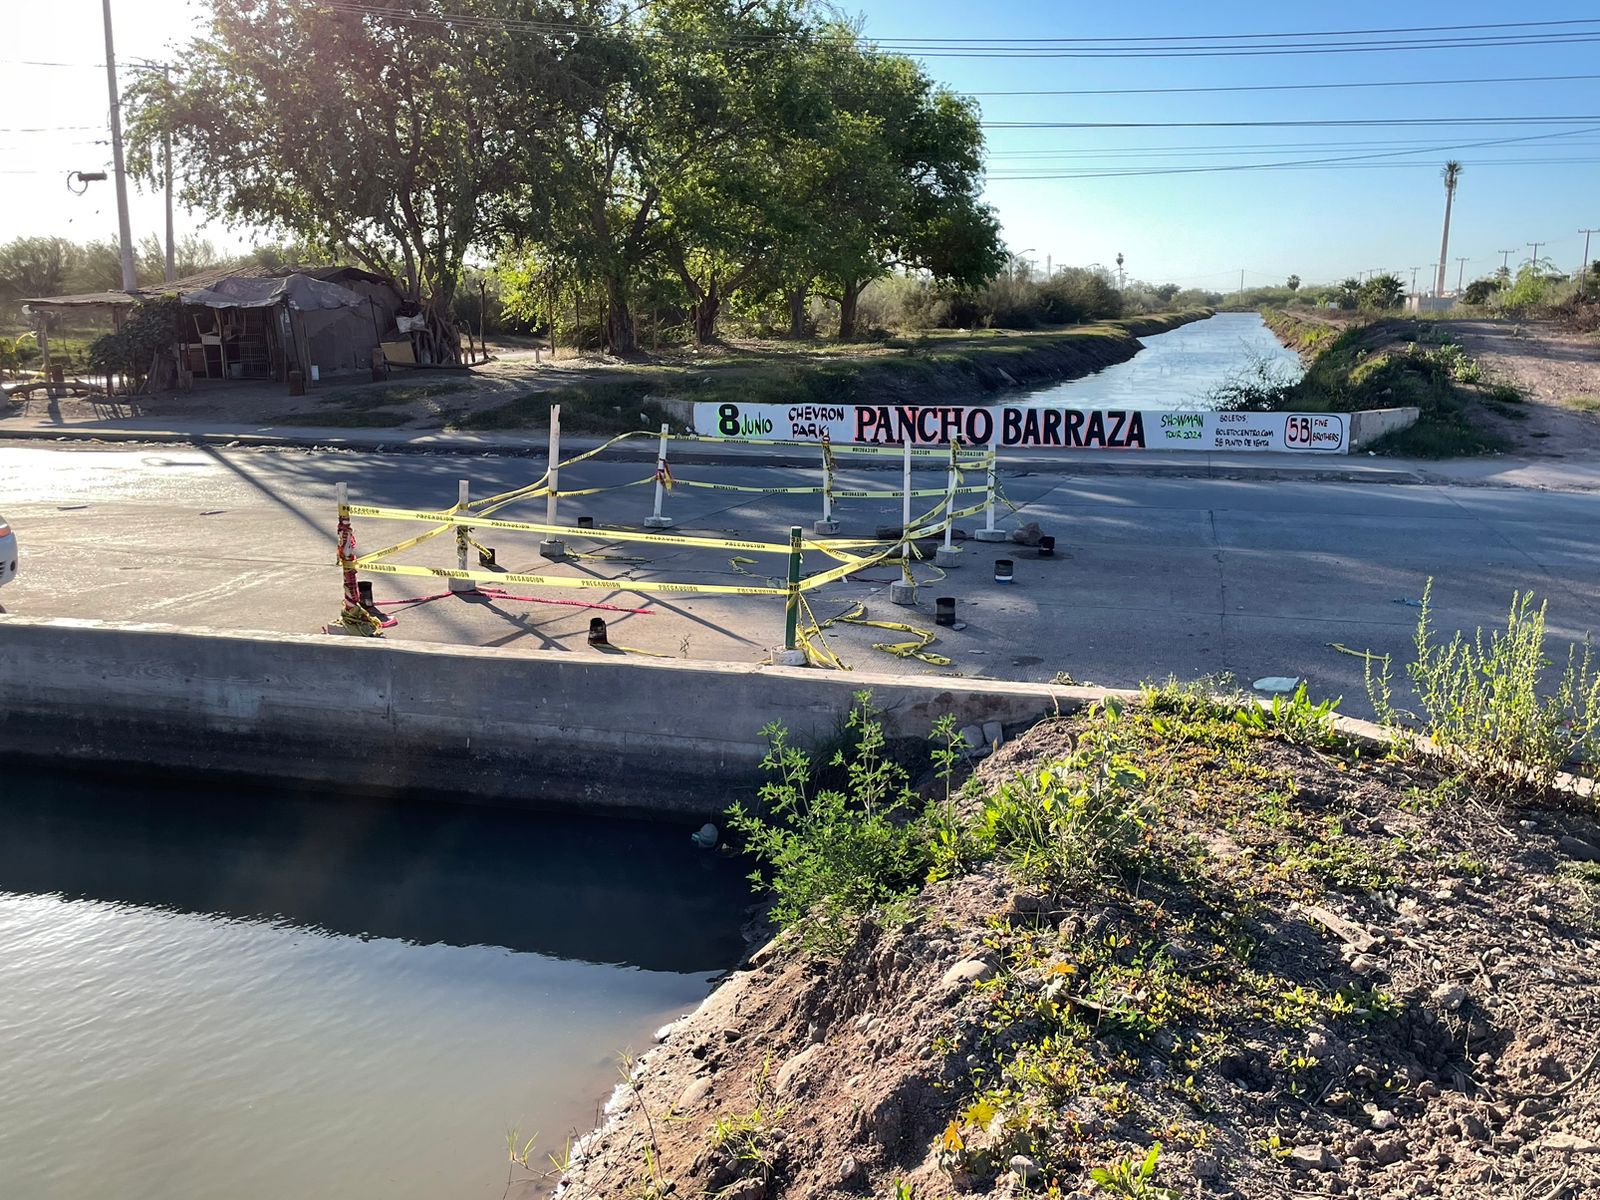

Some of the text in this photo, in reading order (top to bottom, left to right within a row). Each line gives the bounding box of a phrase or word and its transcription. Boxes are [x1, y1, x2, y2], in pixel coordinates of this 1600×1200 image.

[718, 404, 772, 436] 8 JUNIO
[788, 406, 844, 422] CHEVRON
[1160, 414, 1204, 428] SHOWMAN
[854, 406, 1146, 448] PANCHO BARRAZA
[1314, 418, 1328, 428] FIVE
[792, 423, 829, 438] PARK
[1166, 430, 1202, 439] TOUR 2024
[1288, 418, 1310, 443] 5B
[1312, 432, 1340, 442] BROTHERS
[506, 575, 545, 583] PRECAUCION
[581, 580, 621, 588] PRECAUCION
